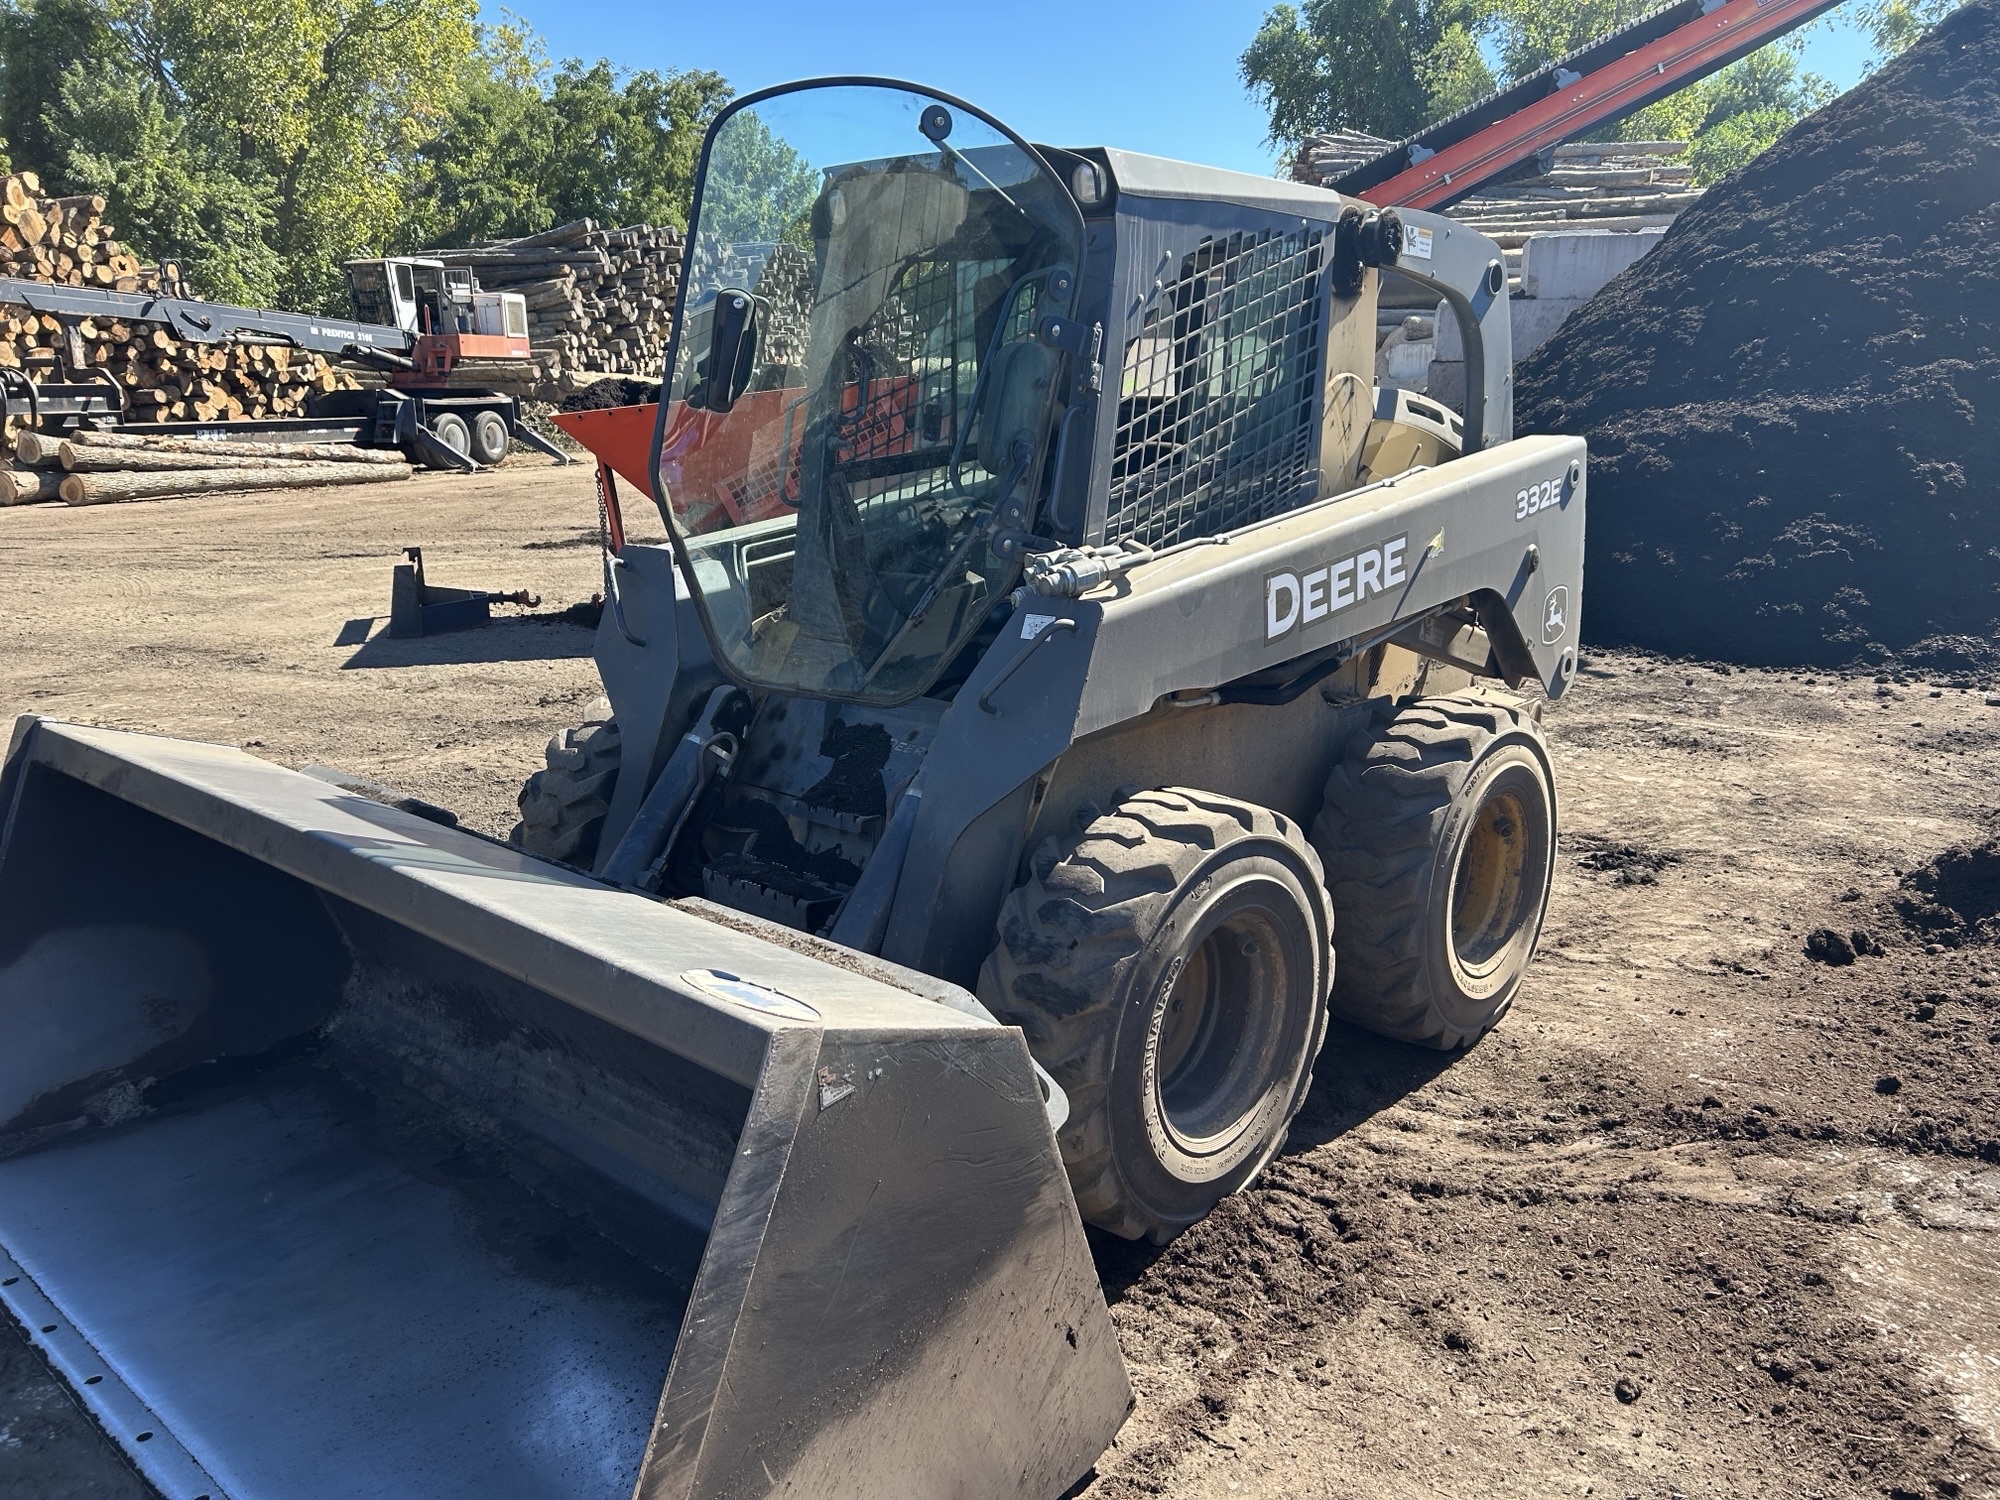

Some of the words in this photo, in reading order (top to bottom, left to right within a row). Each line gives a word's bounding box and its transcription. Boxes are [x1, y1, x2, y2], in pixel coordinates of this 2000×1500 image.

[1515, 477, 1562, 520] 332E
[1267, 537, 1407, 639] DEERE
[1143, 956, 1183, 1097] GUARD
